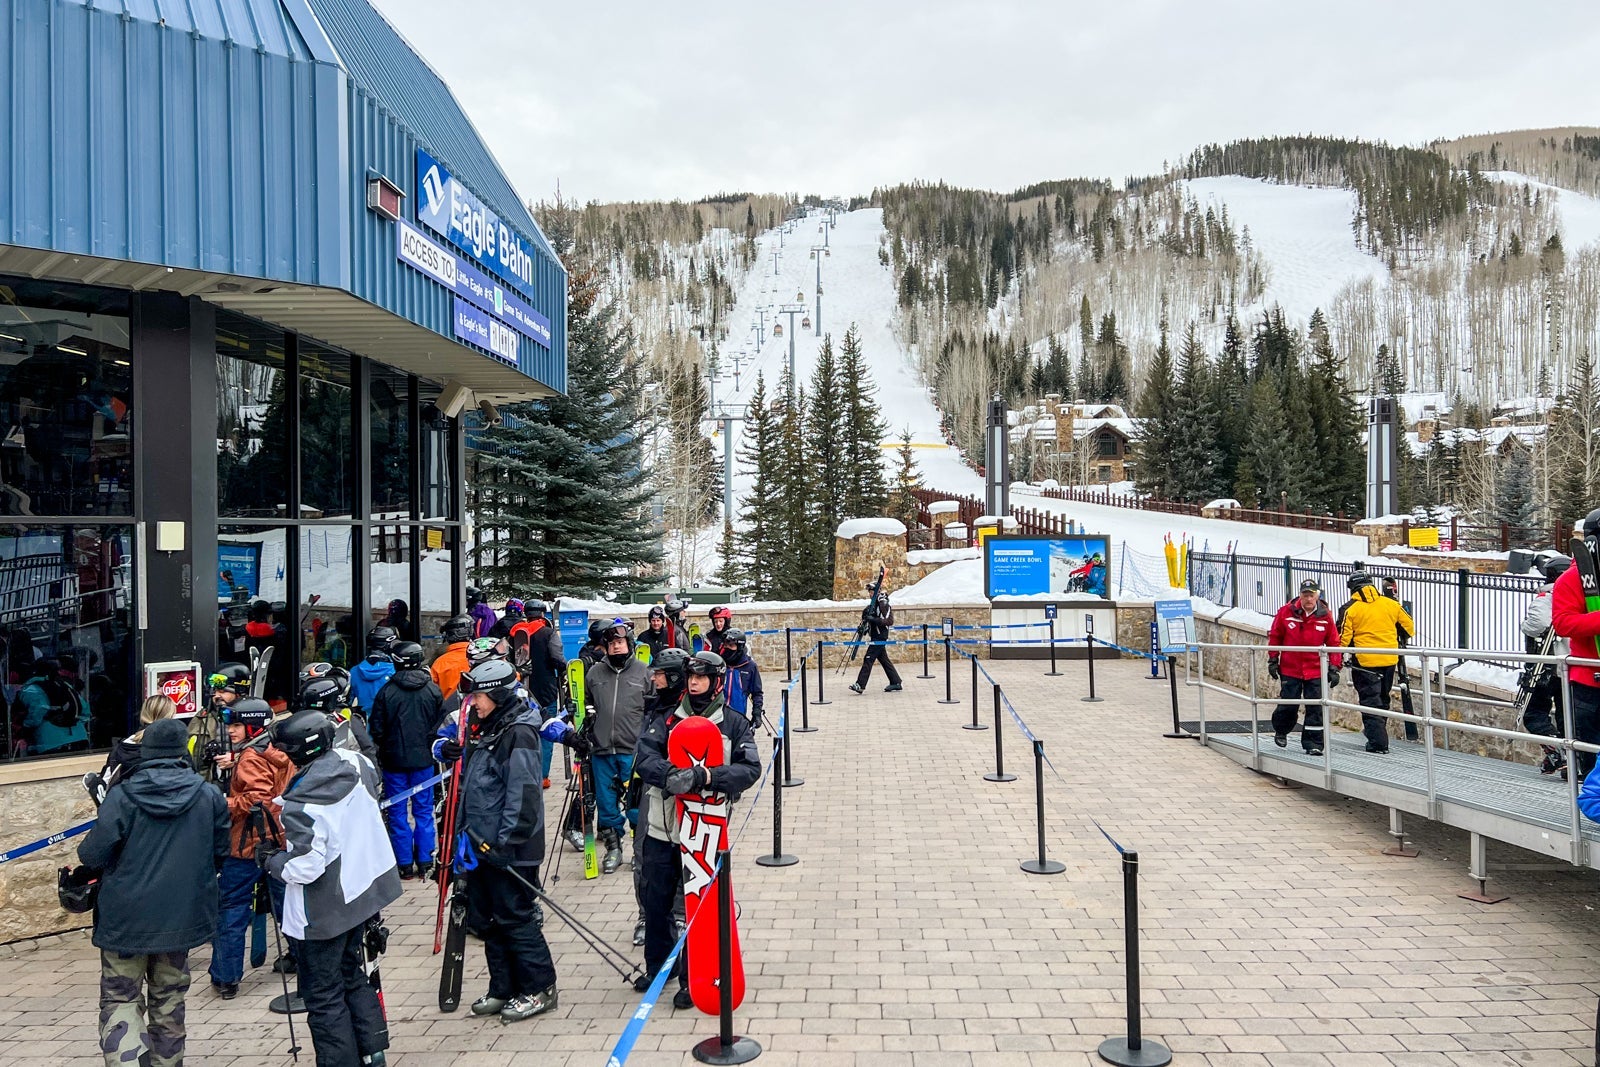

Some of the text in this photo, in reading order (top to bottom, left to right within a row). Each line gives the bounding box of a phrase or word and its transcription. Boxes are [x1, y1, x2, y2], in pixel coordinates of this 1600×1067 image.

[451, 179, 533, 287] Eagle Bahn
[403, 231, 455, 281] ACCESS TO:
[456, 269, 469, 288] Little
[470, 278, 484, 297] Eagle
[165, 684, 189, 696] DEFIB
[478, 680, 502, 689] SMITH
[53, 832, 67, 842] VAIL
[0, 854, 9, 862] AIL
[585, 853, 592, 870] RS
